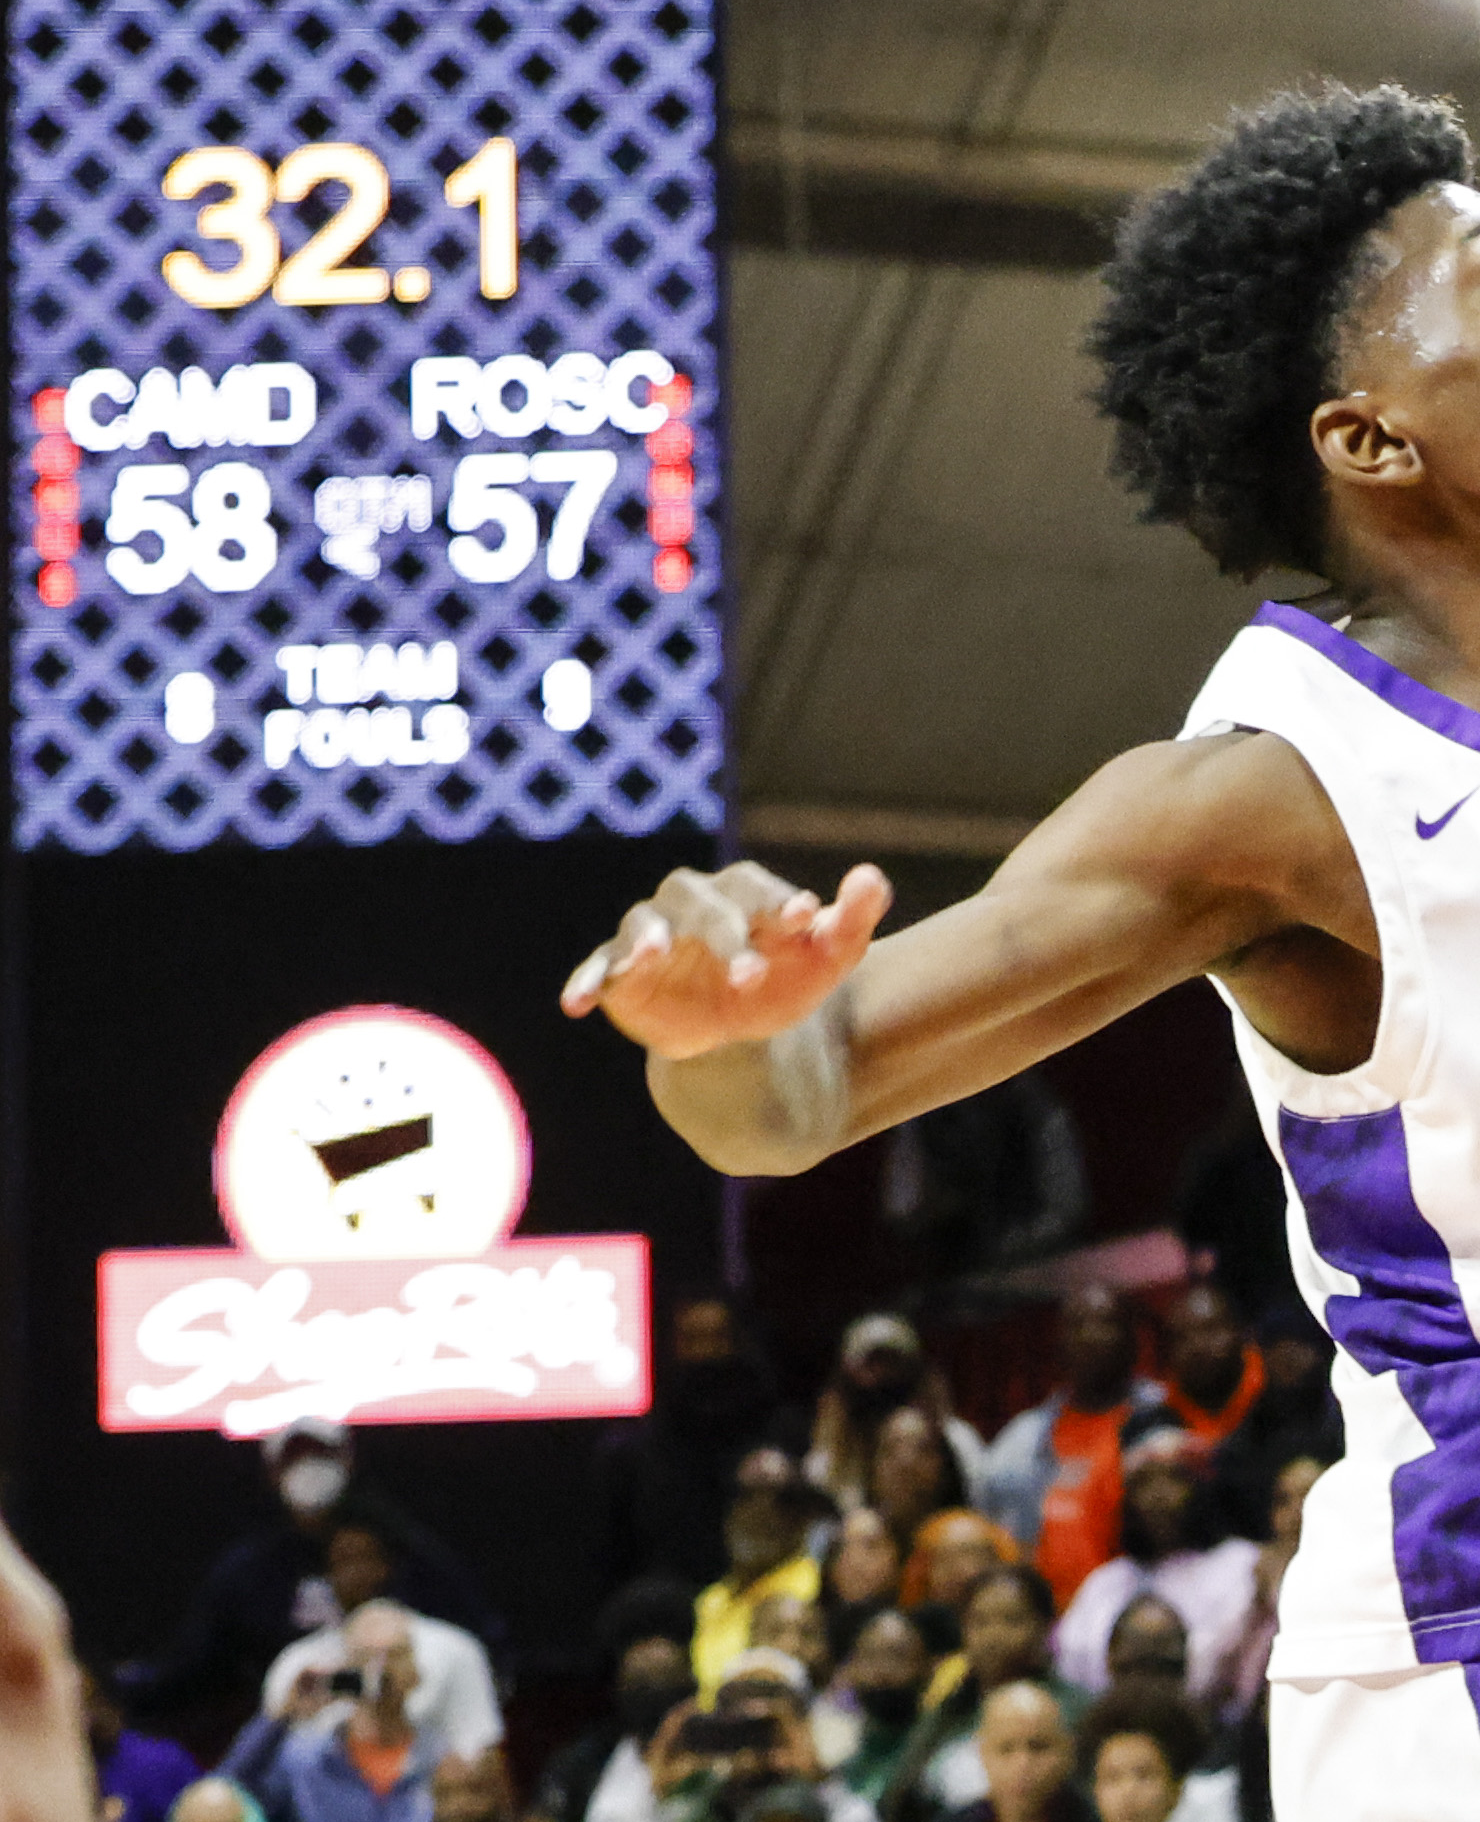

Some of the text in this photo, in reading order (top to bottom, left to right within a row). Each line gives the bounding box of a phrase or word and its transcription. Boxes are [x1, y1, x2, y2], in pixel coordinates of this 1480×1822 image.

[161, 137, 519, 309] 32.1
[64, 361, 317, 451] CAMD
[411, 350, 675, 441] ROSC
[105, 462, 278, 595] 58
[447, 450, 618, 583] 57
[264, 640, 470, 770] TEAM FOULS
